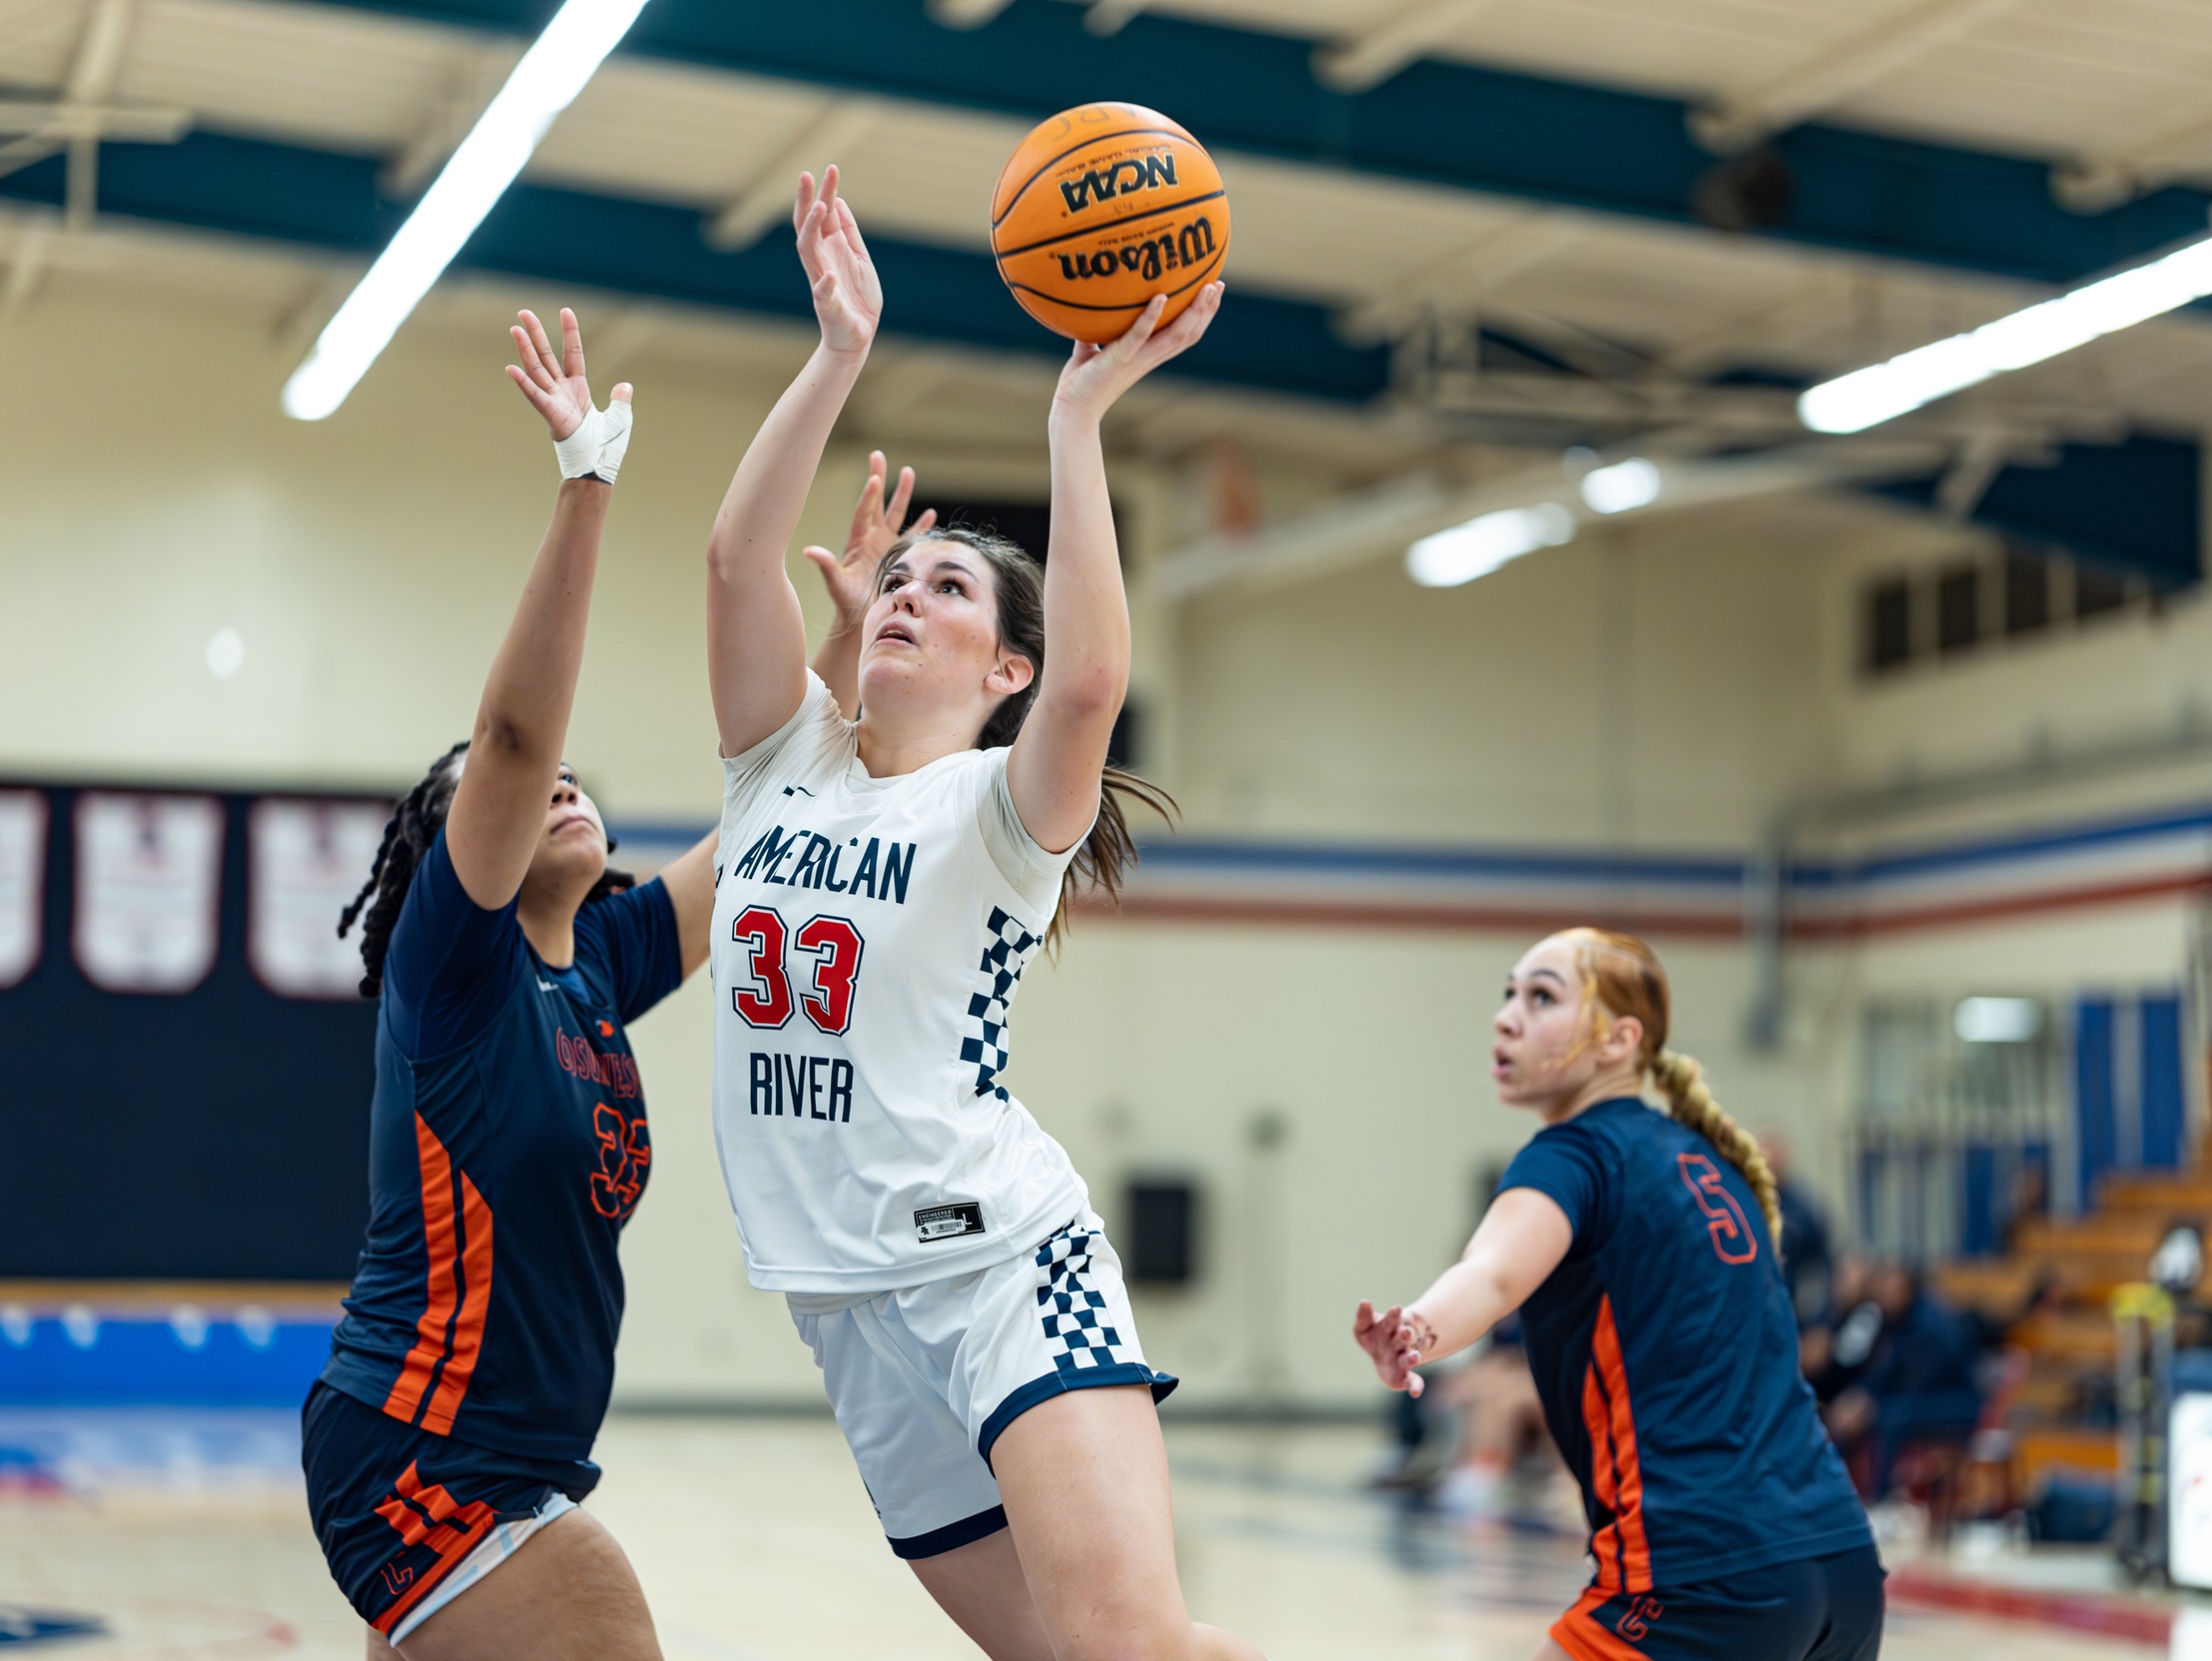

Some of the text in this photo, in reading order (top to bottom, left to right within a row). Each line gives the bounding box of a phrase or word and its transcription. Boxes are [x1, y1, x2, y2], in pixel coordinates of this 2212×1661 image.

[1059, 153, 1179, 216] NCAA
[1057, 216, 1216, 282] Wilson
[734, 824, 918, 905] AMERICAN
[732, 904, 866, 1038] 33
[749, 1051, 855, 1124] RIVER
[1678, 1153, 1758, 1265] 5
